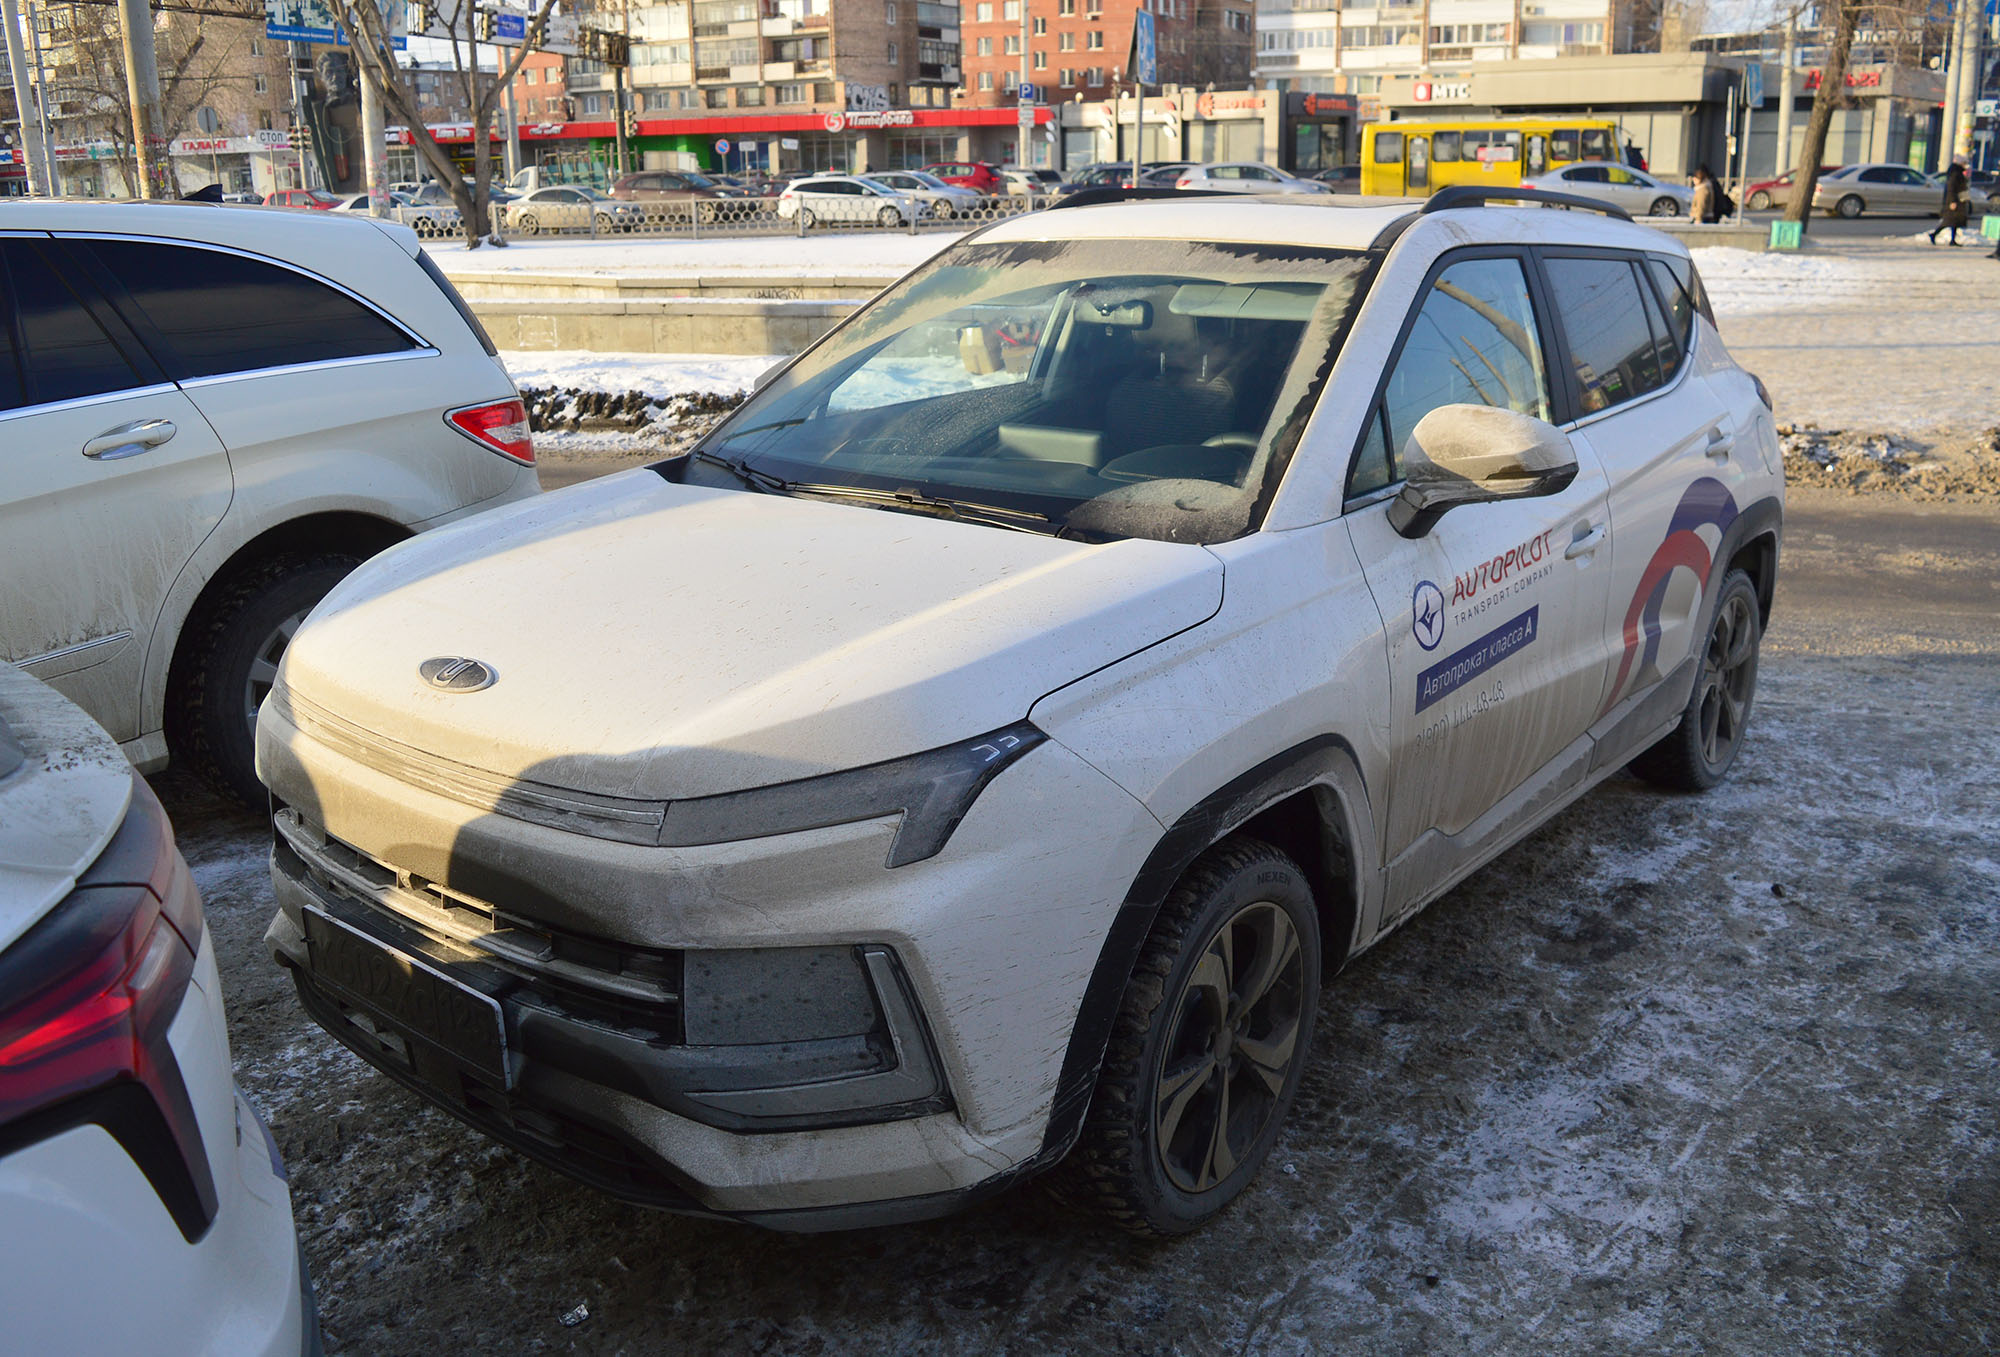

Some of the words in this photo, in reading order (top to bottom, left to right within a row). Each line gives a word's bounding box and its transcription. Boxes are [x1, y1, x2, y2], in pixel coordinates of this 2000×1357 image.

[1804, 69, 1880, 90] Дьга
[1432, 83, 1470, 99] МТС
[182, 140, 228, 151] ГАЛАНТ
[260, 132, 283, 142] СТОП
[1452, 529, 1553, 606] AUTOPILOT
[1454, 587, 1510, 626] TRANSPORT
[1514, 562, 1554, 594] COMPANY
[1423, 646, 1489, 701] Автопрокат
[1489, 626, 1524, 659] класса
[1256, 871, 1292, 888] NEXEN
